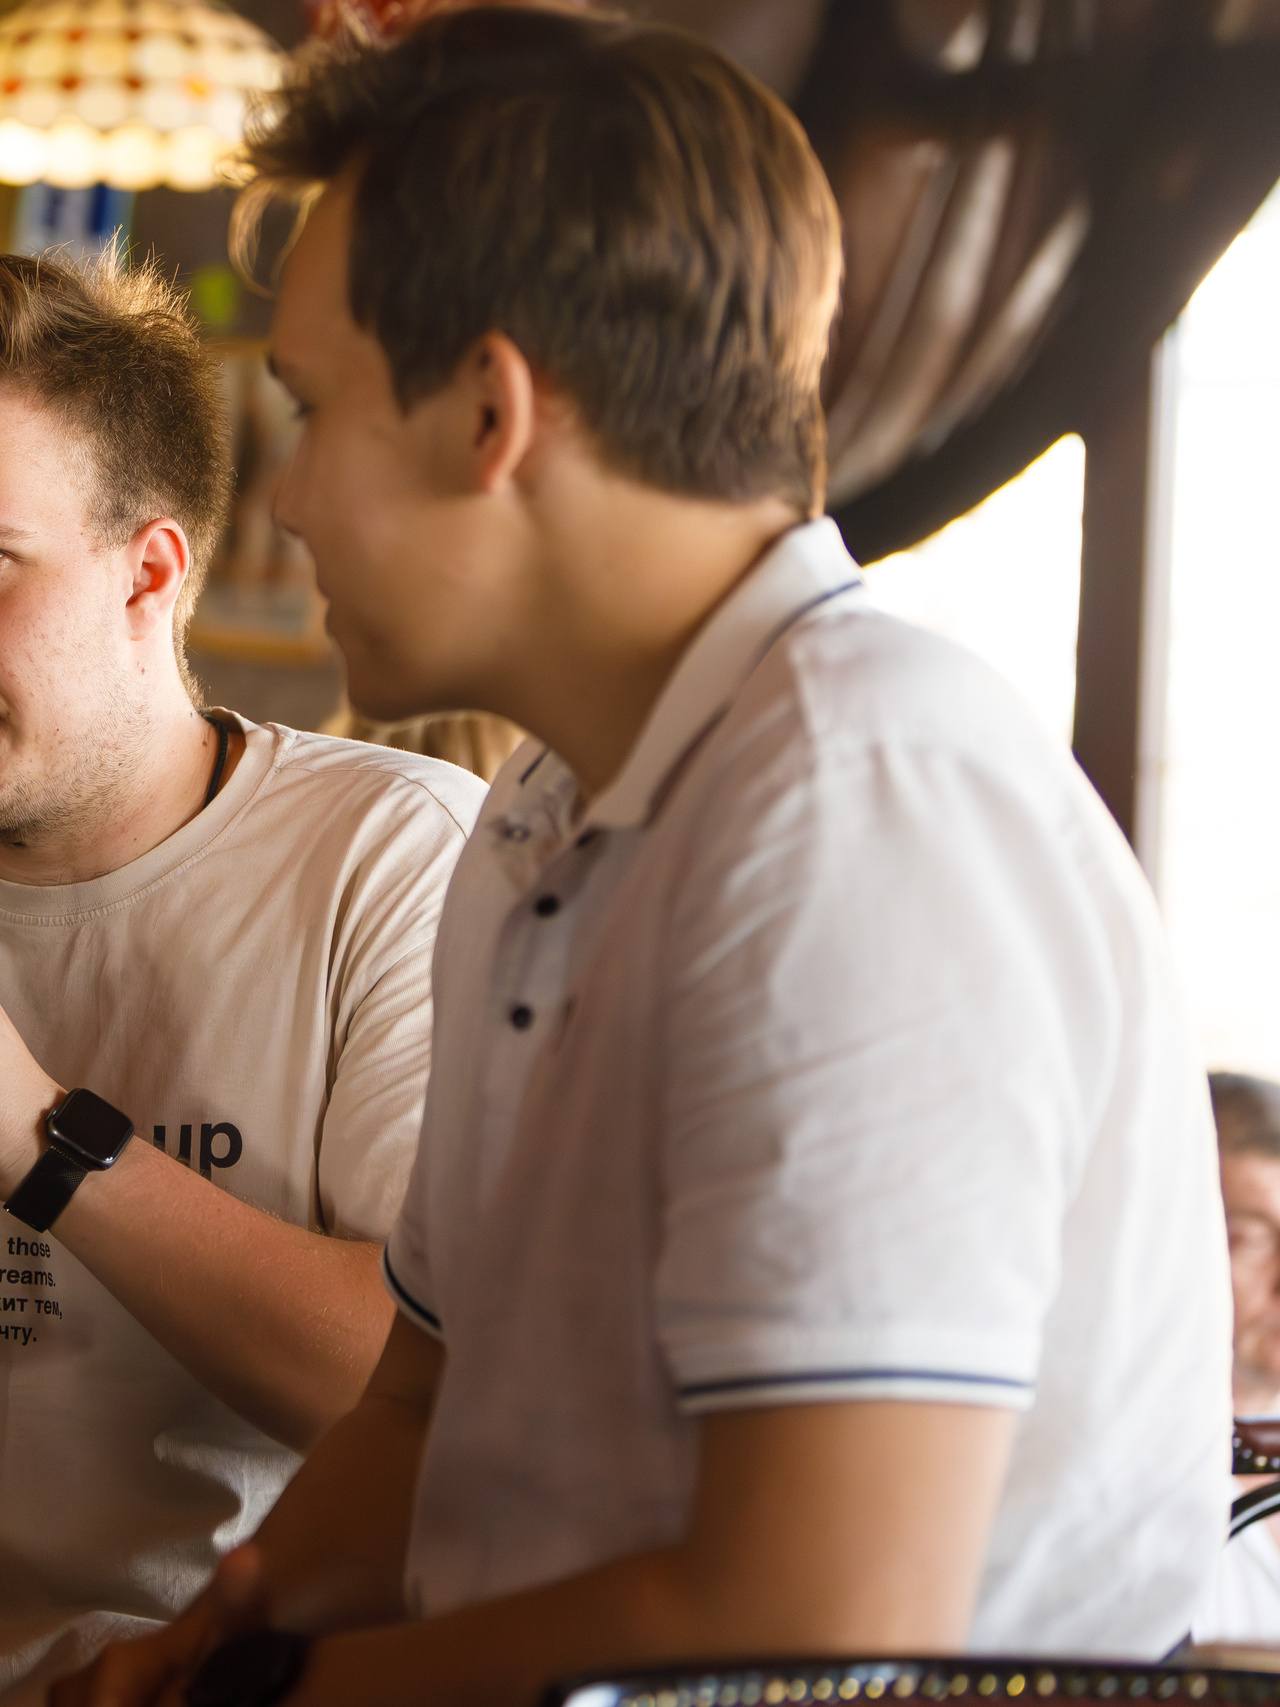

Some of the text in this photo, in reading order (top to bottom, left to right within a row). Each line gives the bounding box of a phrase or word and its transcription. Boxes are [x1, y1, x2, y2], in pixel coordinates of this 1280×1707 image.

[152, 1122, 243, 1181] up
[7, 1237, 51, 1258] those
[34, 1299, 62, 1319] тем,
